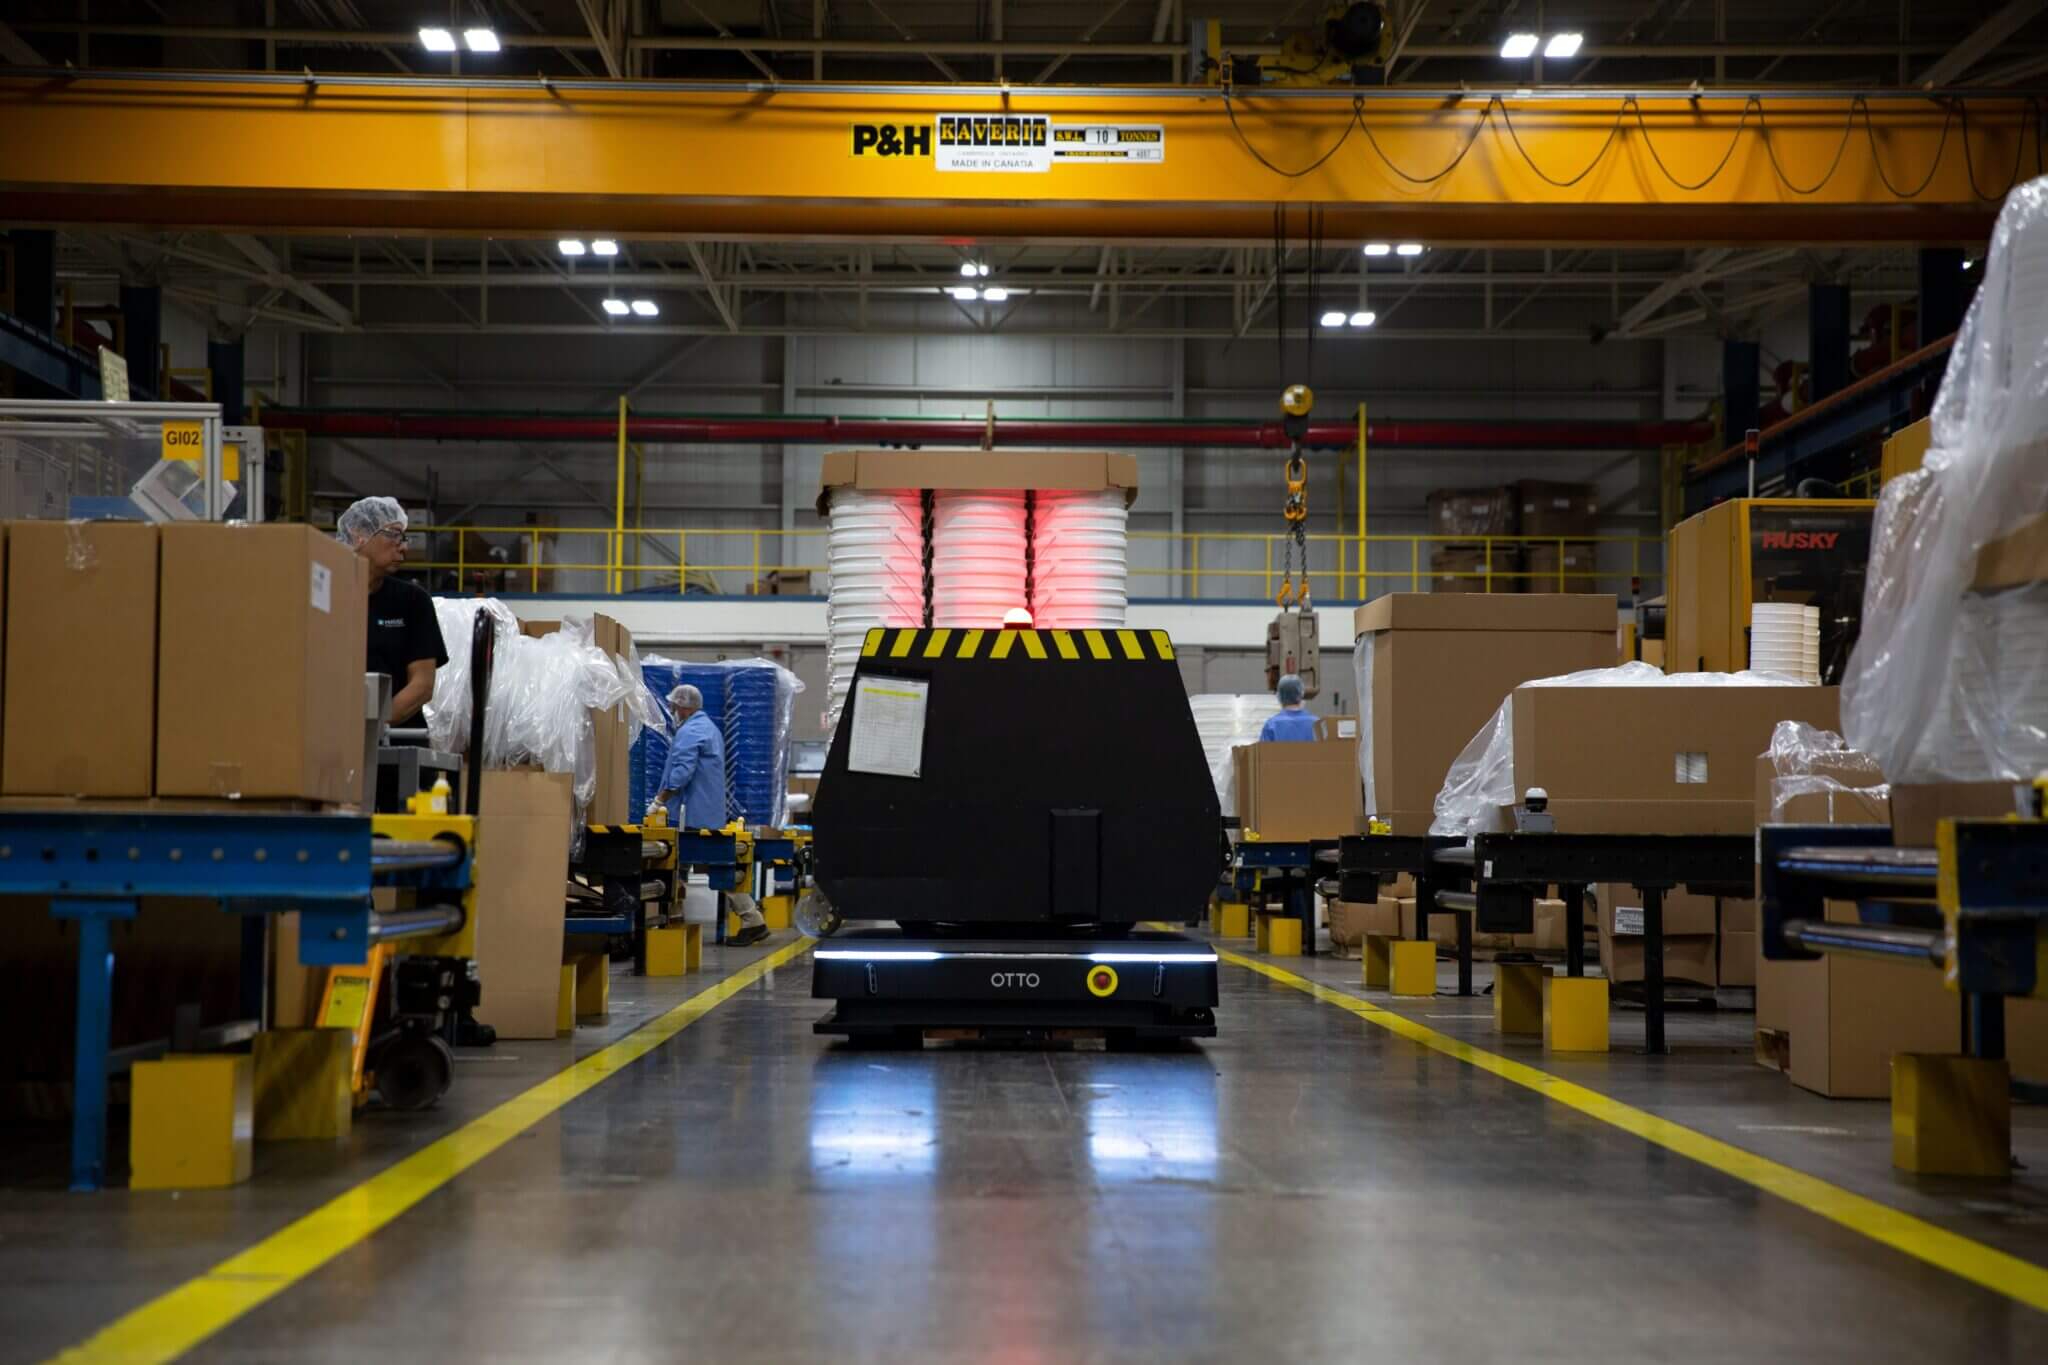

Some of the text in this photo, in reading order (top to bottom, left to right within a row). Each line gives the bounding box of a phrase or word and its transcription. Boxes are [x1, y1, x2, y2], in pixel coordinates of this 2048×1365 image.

[853, 124, 930, 156] P&H
[941, 122, 1045, 141] KAVERIT
[1096, 129, 1109, 144] 10
[1120, 131, 1158, 142] TONNES
[951, 159, 977, 168] MADE
[982, 159, 991, 168] IN
[1762, 530, 1840, 550] HUSKY
[991, 972, 1040, 988] OTTO
